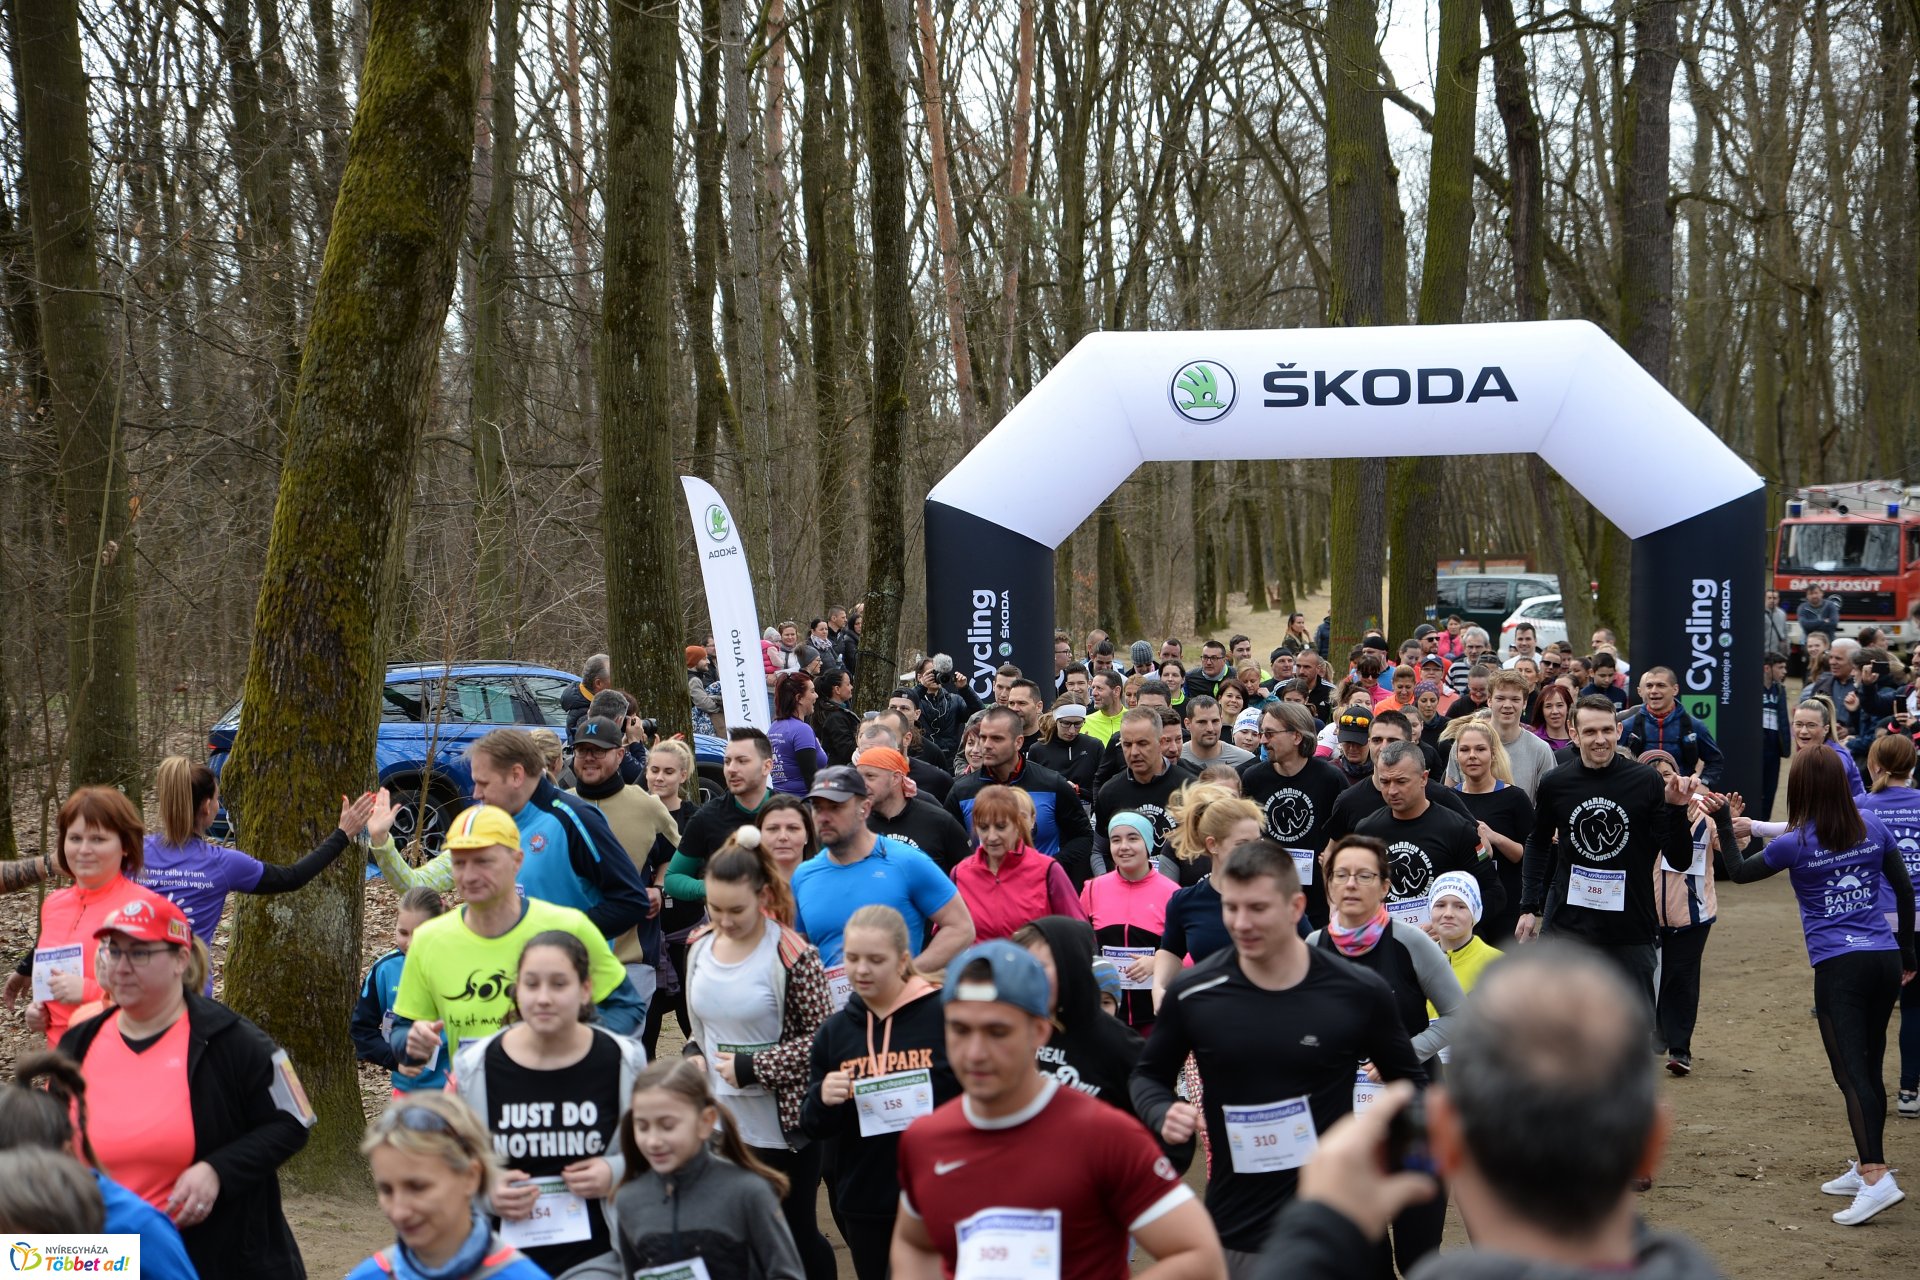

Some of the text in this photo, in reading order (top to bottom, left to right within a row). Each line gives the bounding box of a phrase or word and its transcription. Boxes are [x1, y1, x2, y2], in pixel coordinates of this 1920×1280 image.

[1263, 362, 1519, 407] ŠKODA
[999, 590, 1010, 639] ŠKODA
[1719, 579, 1731, 630] ŠKODA
[967, 589, 997, 700] Cycling
[1685, 579, 1718, 691] Cycling
[1274, 787, 1302, 798] WARRIOR
[1569, 797, 1630, 825] NAKED WARRIOR TEAM
[1388, 841, 1420, 853] WARRIOR
[1419, 850, 1433, 869] TEAM
[1807, 857, 1834, 868] Jótékony
[1835, 850, 1859, 861] sportoló
[1814, 849, 1823, 858] Én
[160, 878, 188, 887] sportoló
[1587, 885, 1602, 895] 288
[1035, 1046, 1068, 1066] REAL
[883, 1098, 903, 1111] 158
[1356, 1093, 1374, 1104] 198
[498, 1101, 598, 1130] JUST DO
[1253, 1134, 1277, 1148] 310
